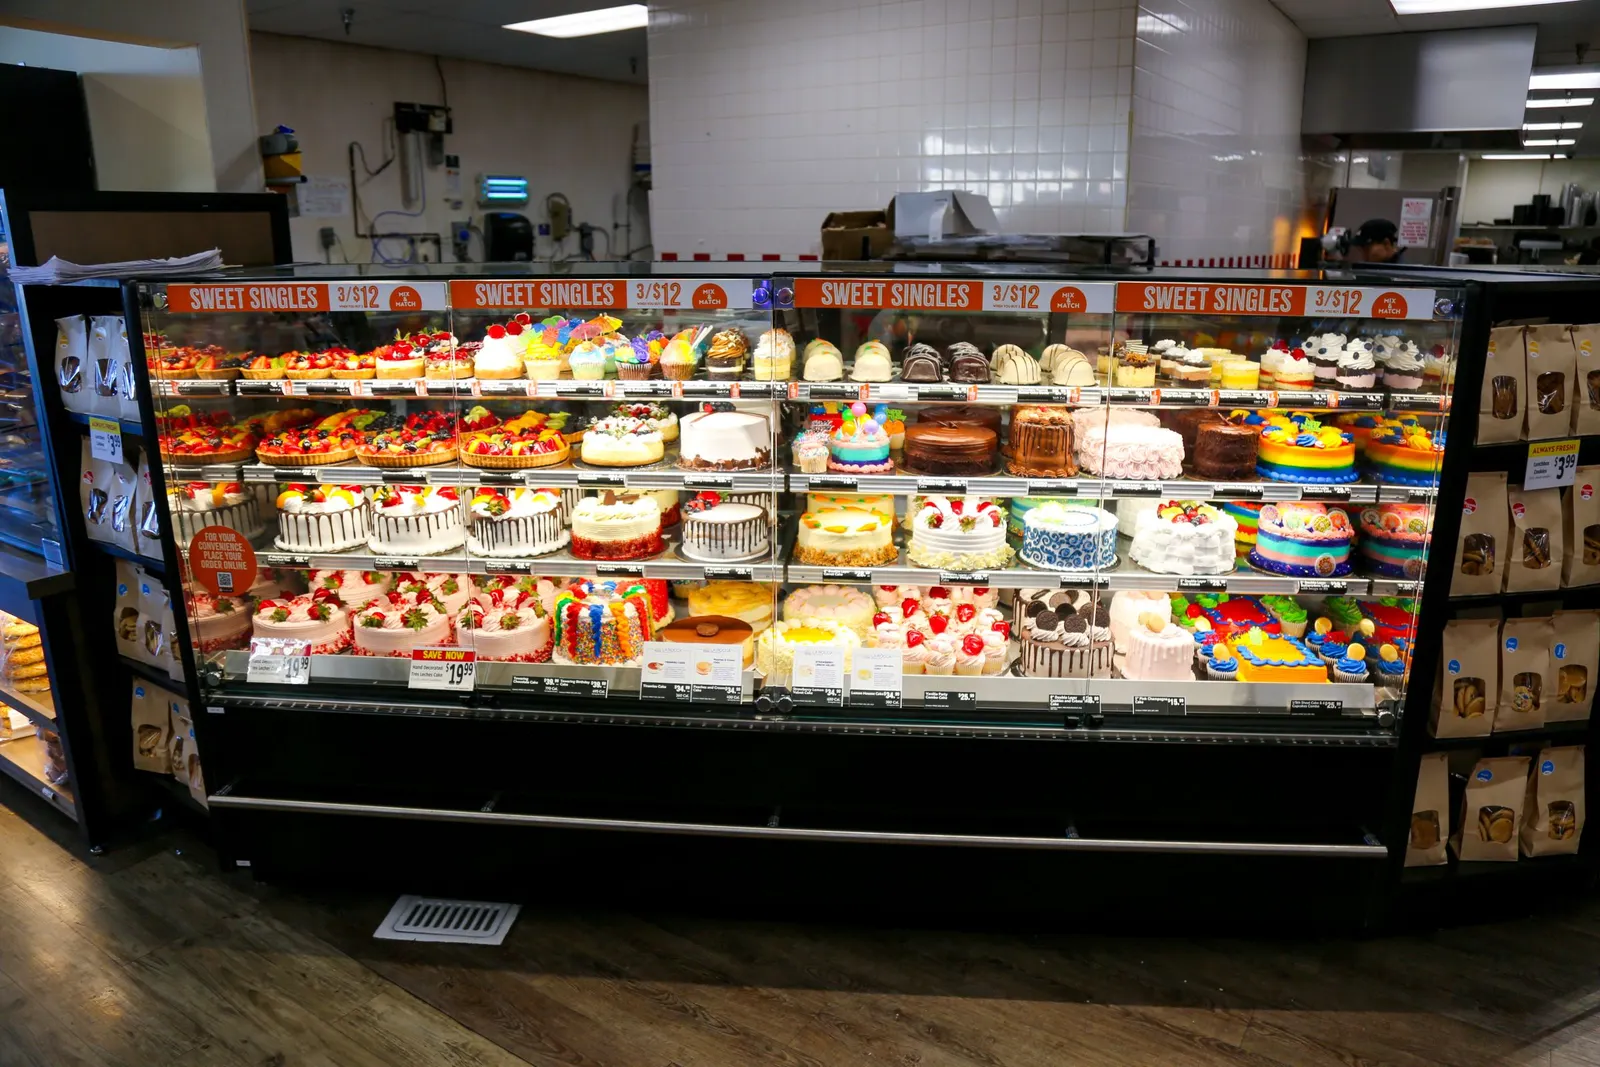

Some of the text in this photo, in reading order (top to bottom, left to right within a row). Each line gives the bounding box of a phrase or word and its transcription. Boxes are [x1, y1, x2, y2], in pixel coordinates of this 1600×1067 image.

[190, 286, 317, 310] SWEET SINGLES
[337, 286, 379, 308] 3/$12
[476, 283, 614, 306] SWEET SINGLES
[636, 282, 681, 306] 3/$12
[821, 282, 970, 307] SWEET SINGLES
[993, 284, 1038, 309] 3/$12
[1144, 286, 1293, 313] SWEET SINGLES
[1315, 289, 1362, 314] 3/$12
[205, 533, 236, 542] FOR YOUR
[201, 560, 247, 570] ORDER ONLINE
[203, 551, 242, 560] PLACE YOUR
[423, 651, 465, 660] SAVE NOW
